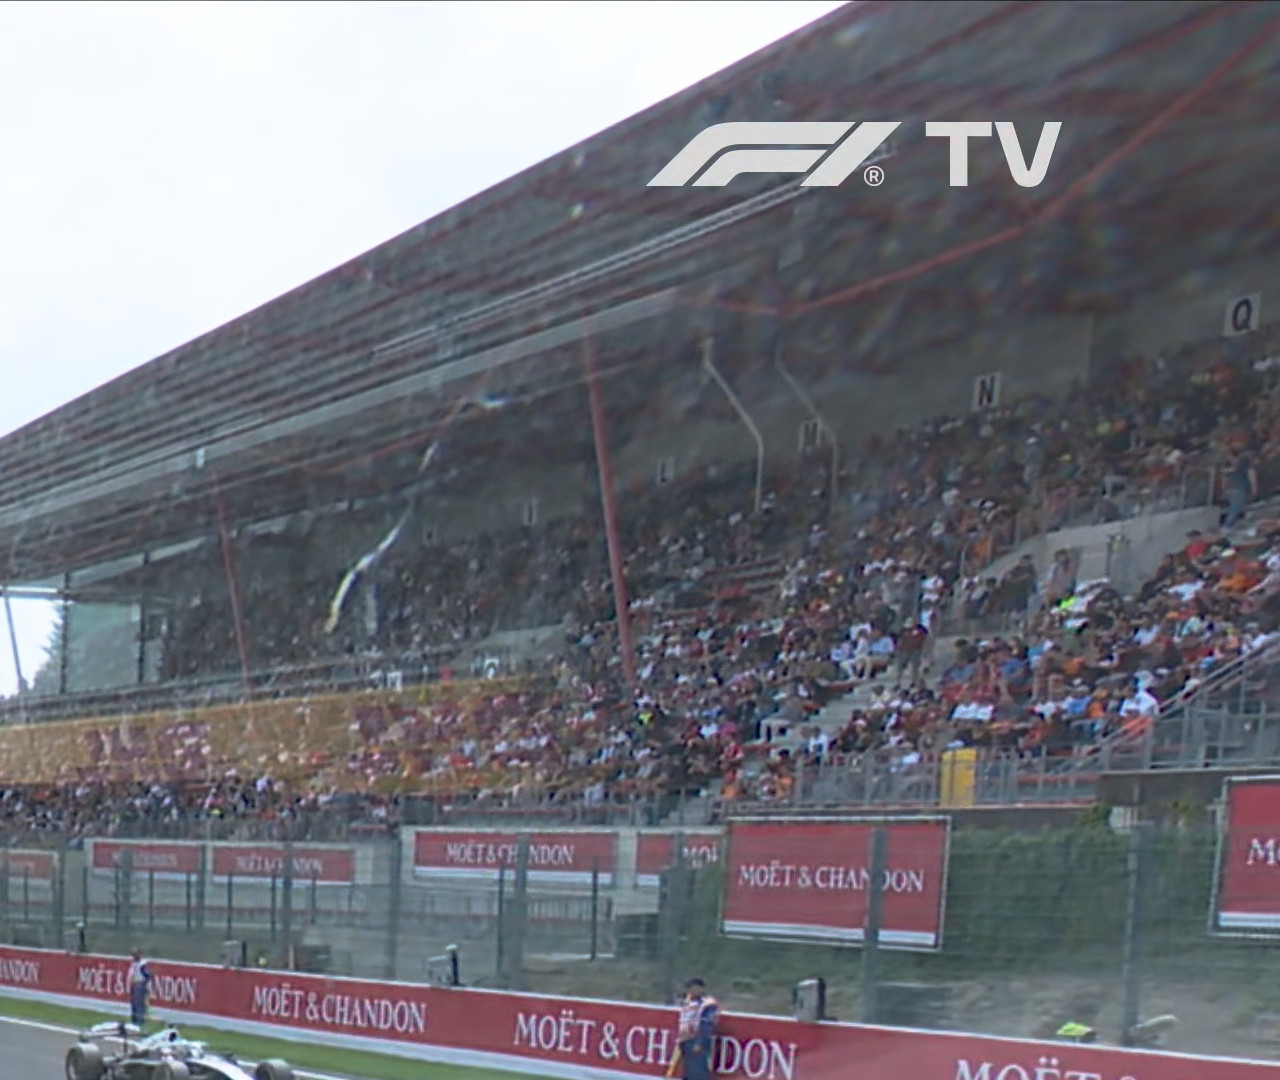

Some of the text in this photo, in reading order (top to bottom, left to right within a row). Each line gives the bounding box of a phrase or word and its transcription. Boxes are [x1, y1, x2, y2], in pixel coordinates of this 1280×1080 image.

[978, 374, 997, 407] N
[498, 843, 576, 865] CHNDON
[738, 860, 796, 888] MOËT
[797, 864, 812, 888] &
[252, 983, 427, 1034] MOËT & CHANDON
[513, 1009, 596, 1054] MOËT
[599, 1021, 620, 1060] &
